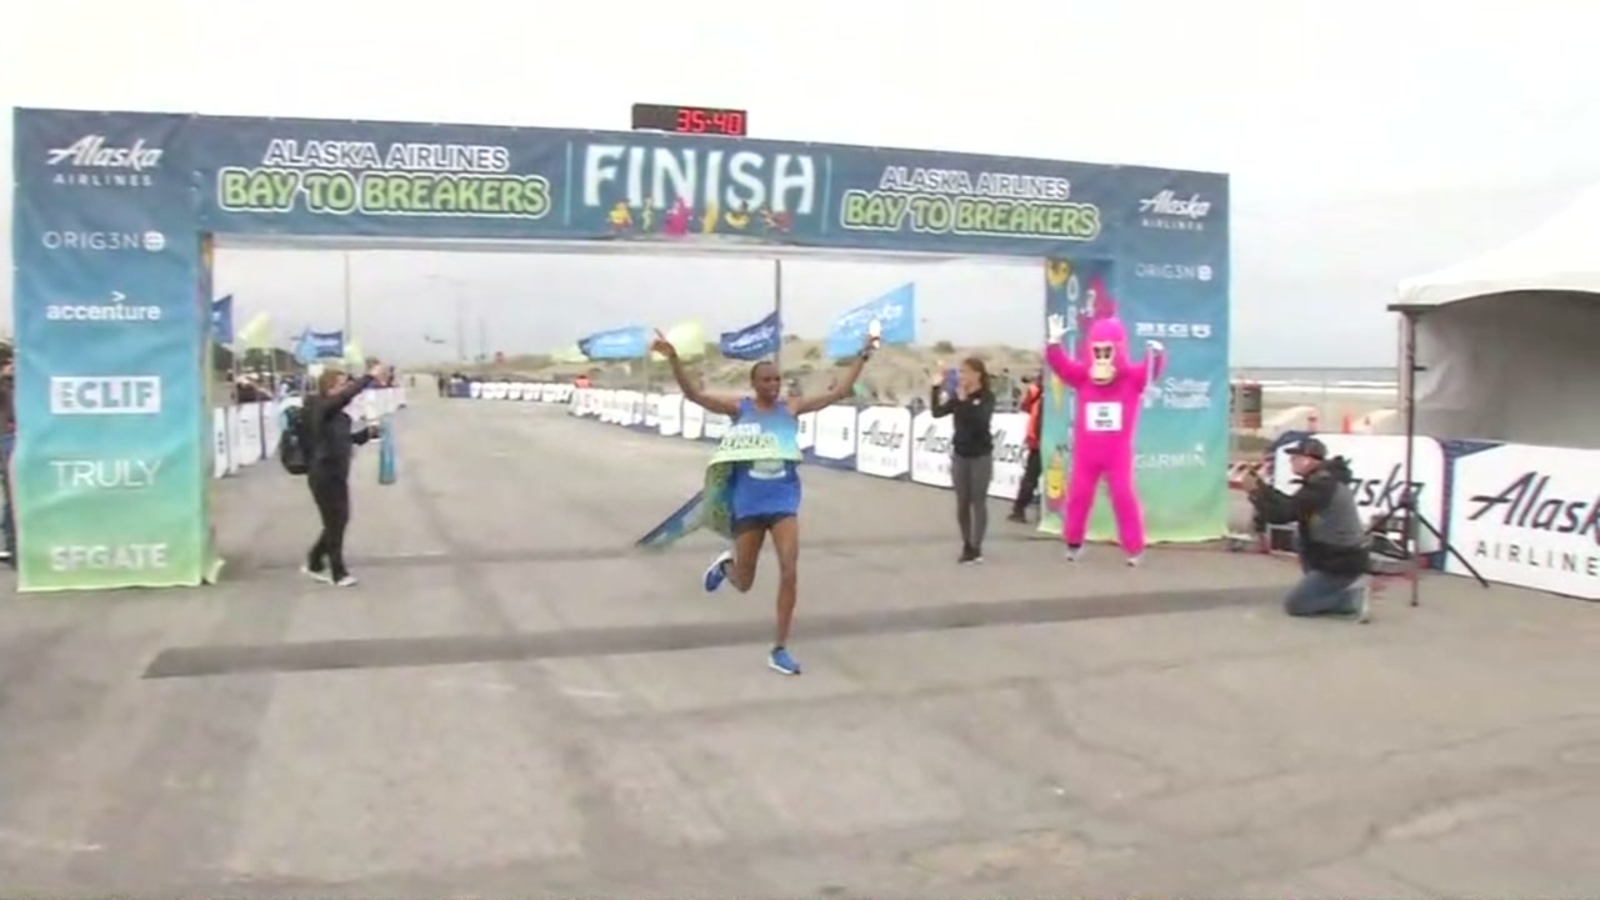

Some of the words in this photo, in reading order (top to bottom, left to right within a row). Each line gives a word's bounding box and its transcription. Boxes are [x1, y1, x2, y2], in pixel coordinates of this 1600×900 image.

[46, 134, 163, 171] Alaska
[262, 138, 382, 168] ALASKA
[385, 143, 511, 173] AIRLINES
[53, 174, 153, 186] AIRLINES
[218, 167, 298, 212] BAY
[301, 170, 356, 212] TO
[358, 173, 551, 219] BREAKERS
[583, 144, 815, 214] FINISH
[879, 166, 972, 195] ALASKA
[974, 172, 1070, 200] AIRLINES
[840, 189, 908, 231] BAY
[909, 193, 952, 233] TO
[952, 196, 1101, 241] BREAKERS
[1139, 189, 1211, 219] Alaska
[42, 231, 139, 250] ORIG3N
[46, 302, 161, 321] accenture
[76, 381, 154, 409] CLIF
[50, 459, 161, 487] TRULY
[52, 544, 168, 572] SFGATE
[1475, 539, 1600, 577] AIRLINE
